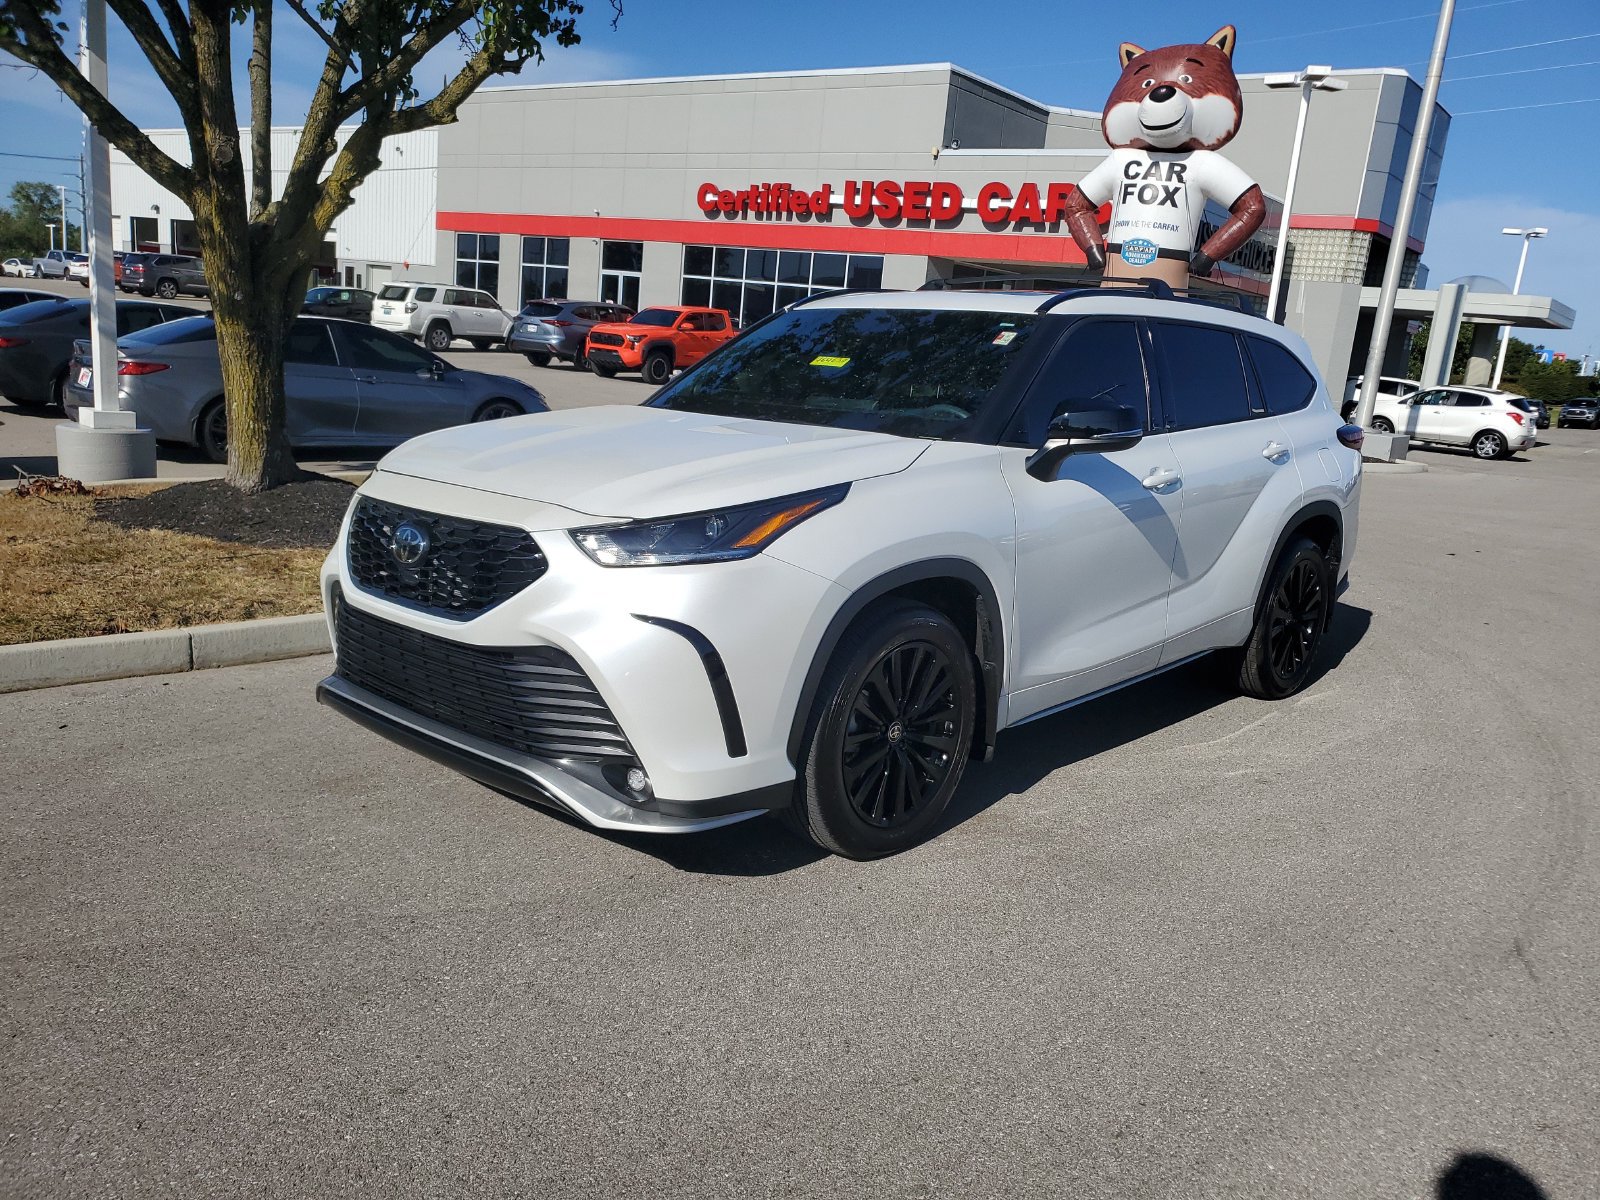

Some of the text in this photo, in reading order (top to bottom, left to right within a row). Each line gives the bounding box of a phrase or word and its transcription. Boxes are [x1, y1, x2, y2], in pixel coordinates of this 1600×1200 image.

[1123, 160, 1187, 184] CAR
[697, 182, 832, 214] Certified
[844, 180, 963, 220] USED
[1122, 183, 1182, 208] FOX
[1131, 220, 1140, 228] ME
[1141, 221, 1152, 229] THE
[1152, 221, 1180, 232] CARFAX
